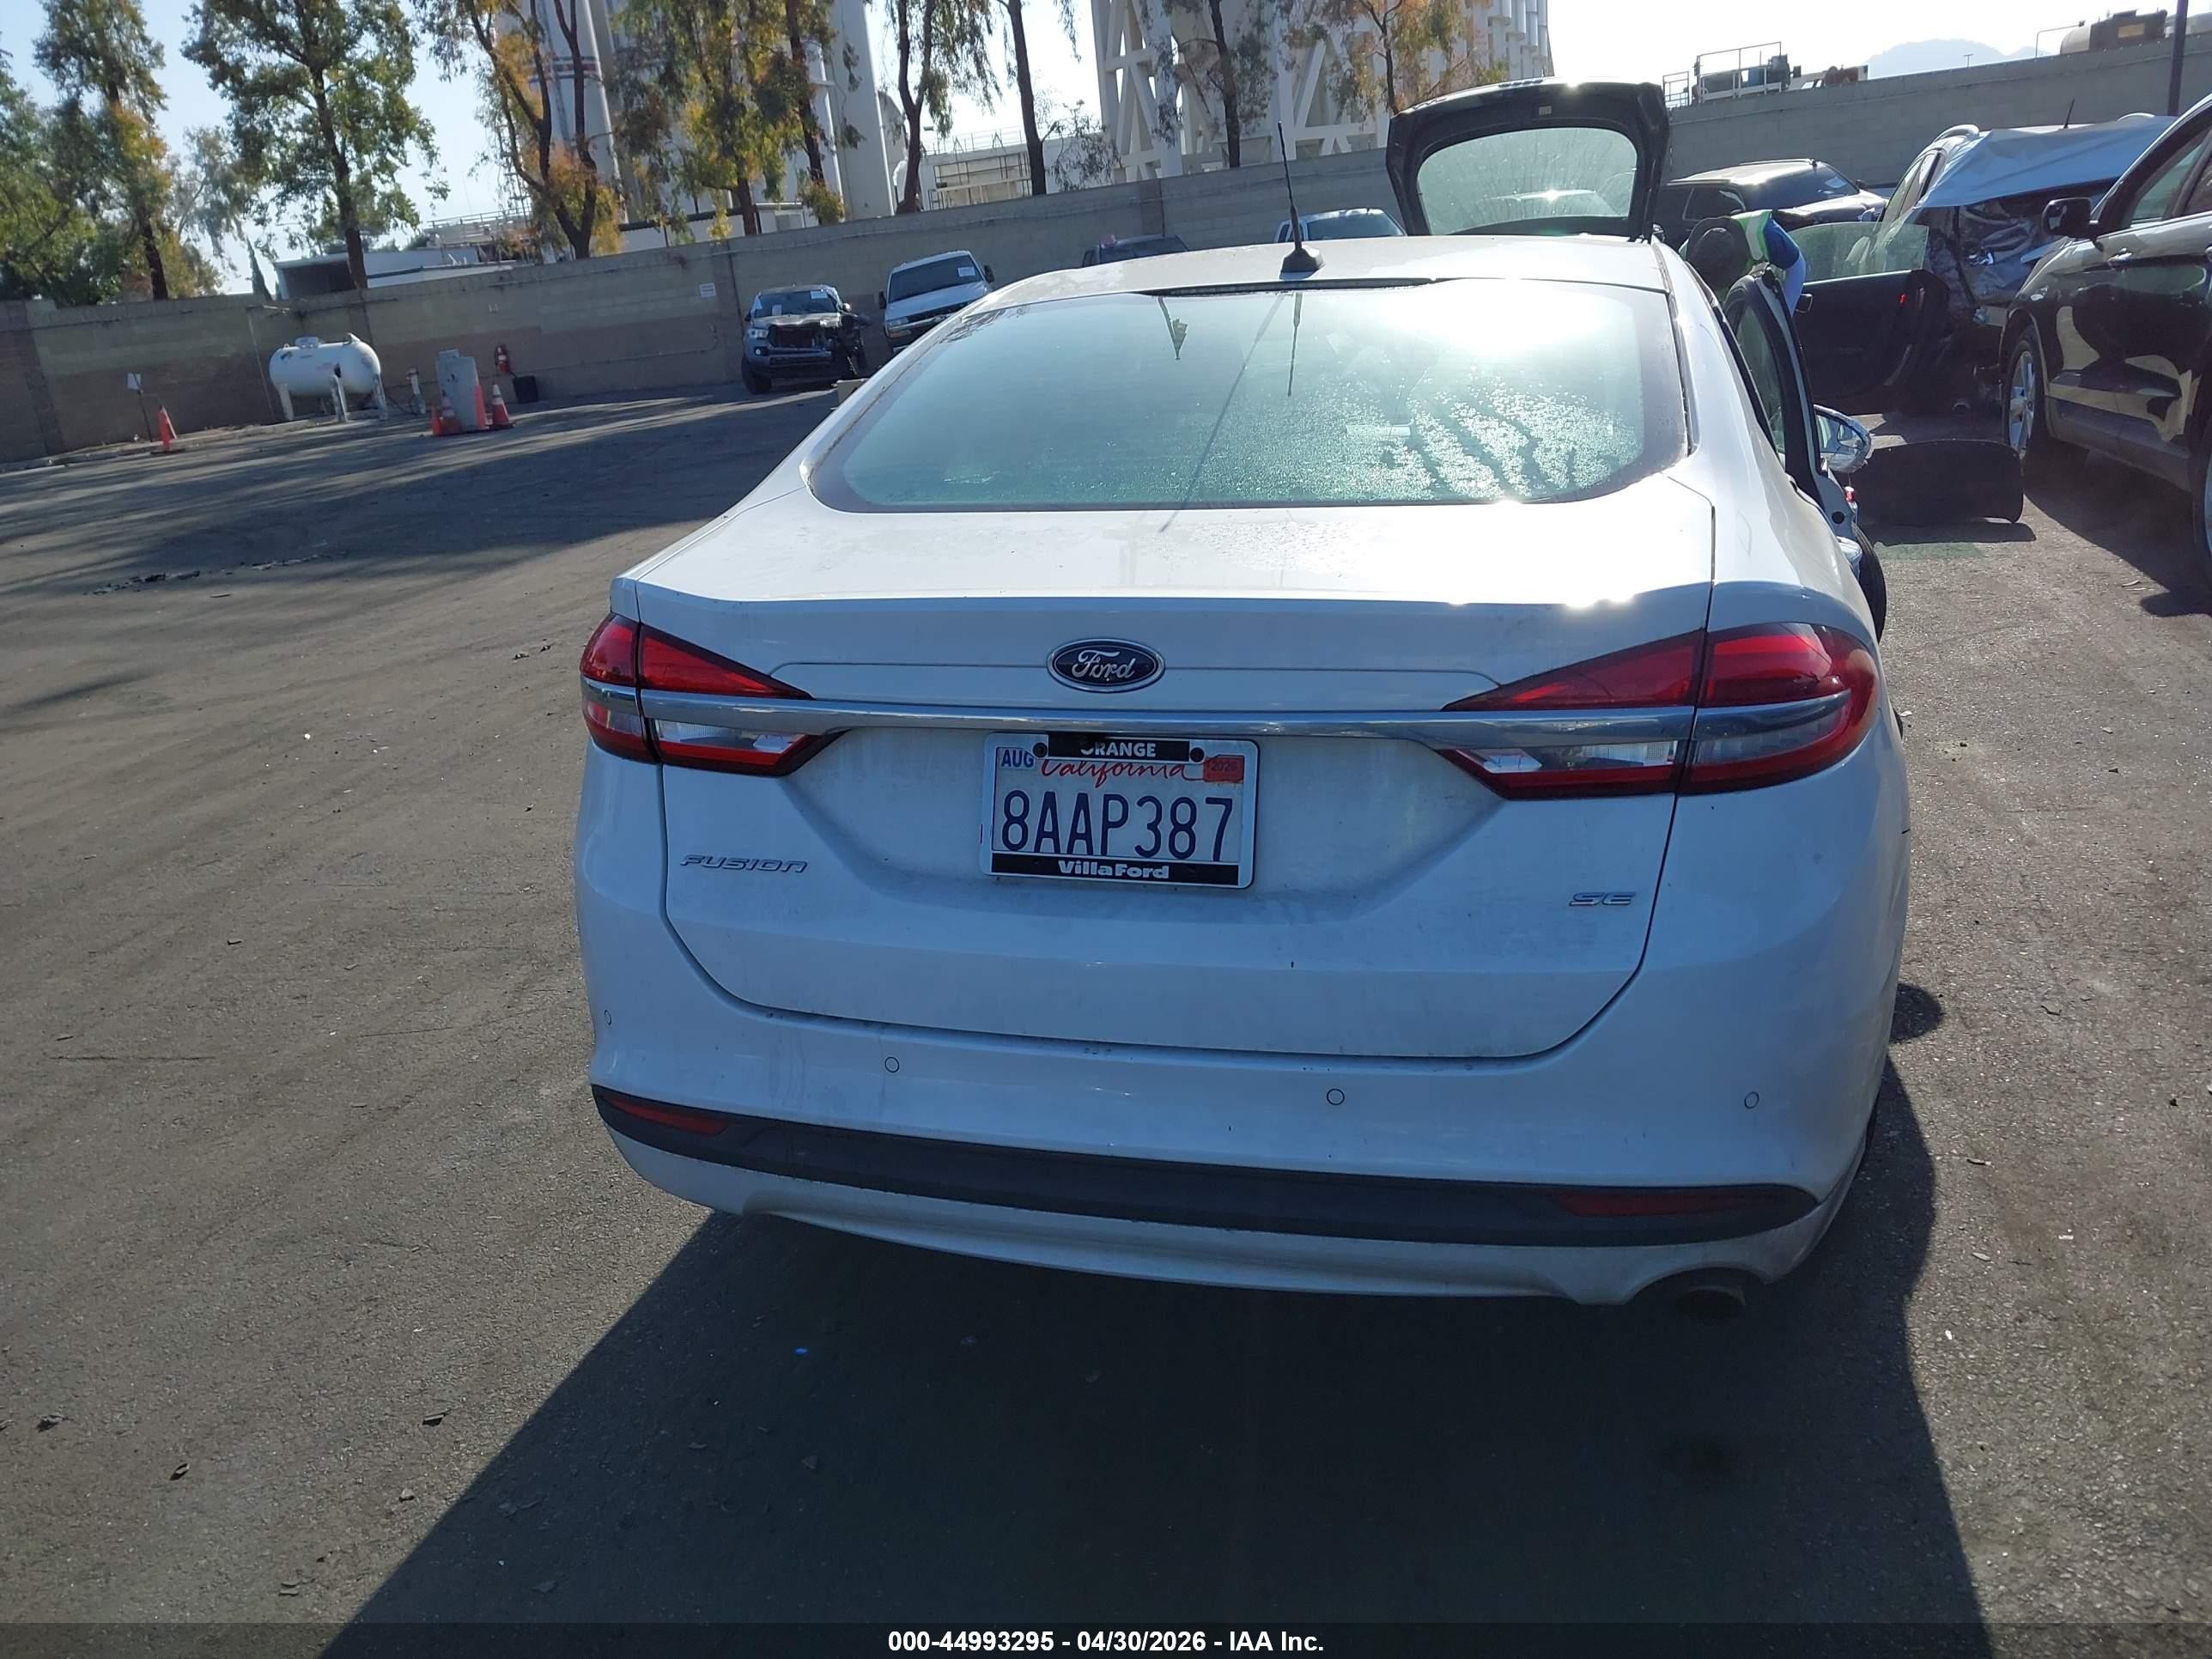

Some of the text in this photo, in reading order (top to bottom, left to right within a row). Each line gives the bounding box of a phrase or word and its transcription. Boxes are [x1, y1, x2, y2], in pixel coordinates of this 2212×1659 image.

[1071, 649, 1137, 678] Ford
[1000, 749, 1035, 769] AUG
[1210, 761, 1237, 771] 202
[1042, 759, 1202, 788] California
[1001, 789, 1234, 862] 8AAP387
[680, 854, 808, 873] FUSION
[1569, 892, 1636, 907] SE
